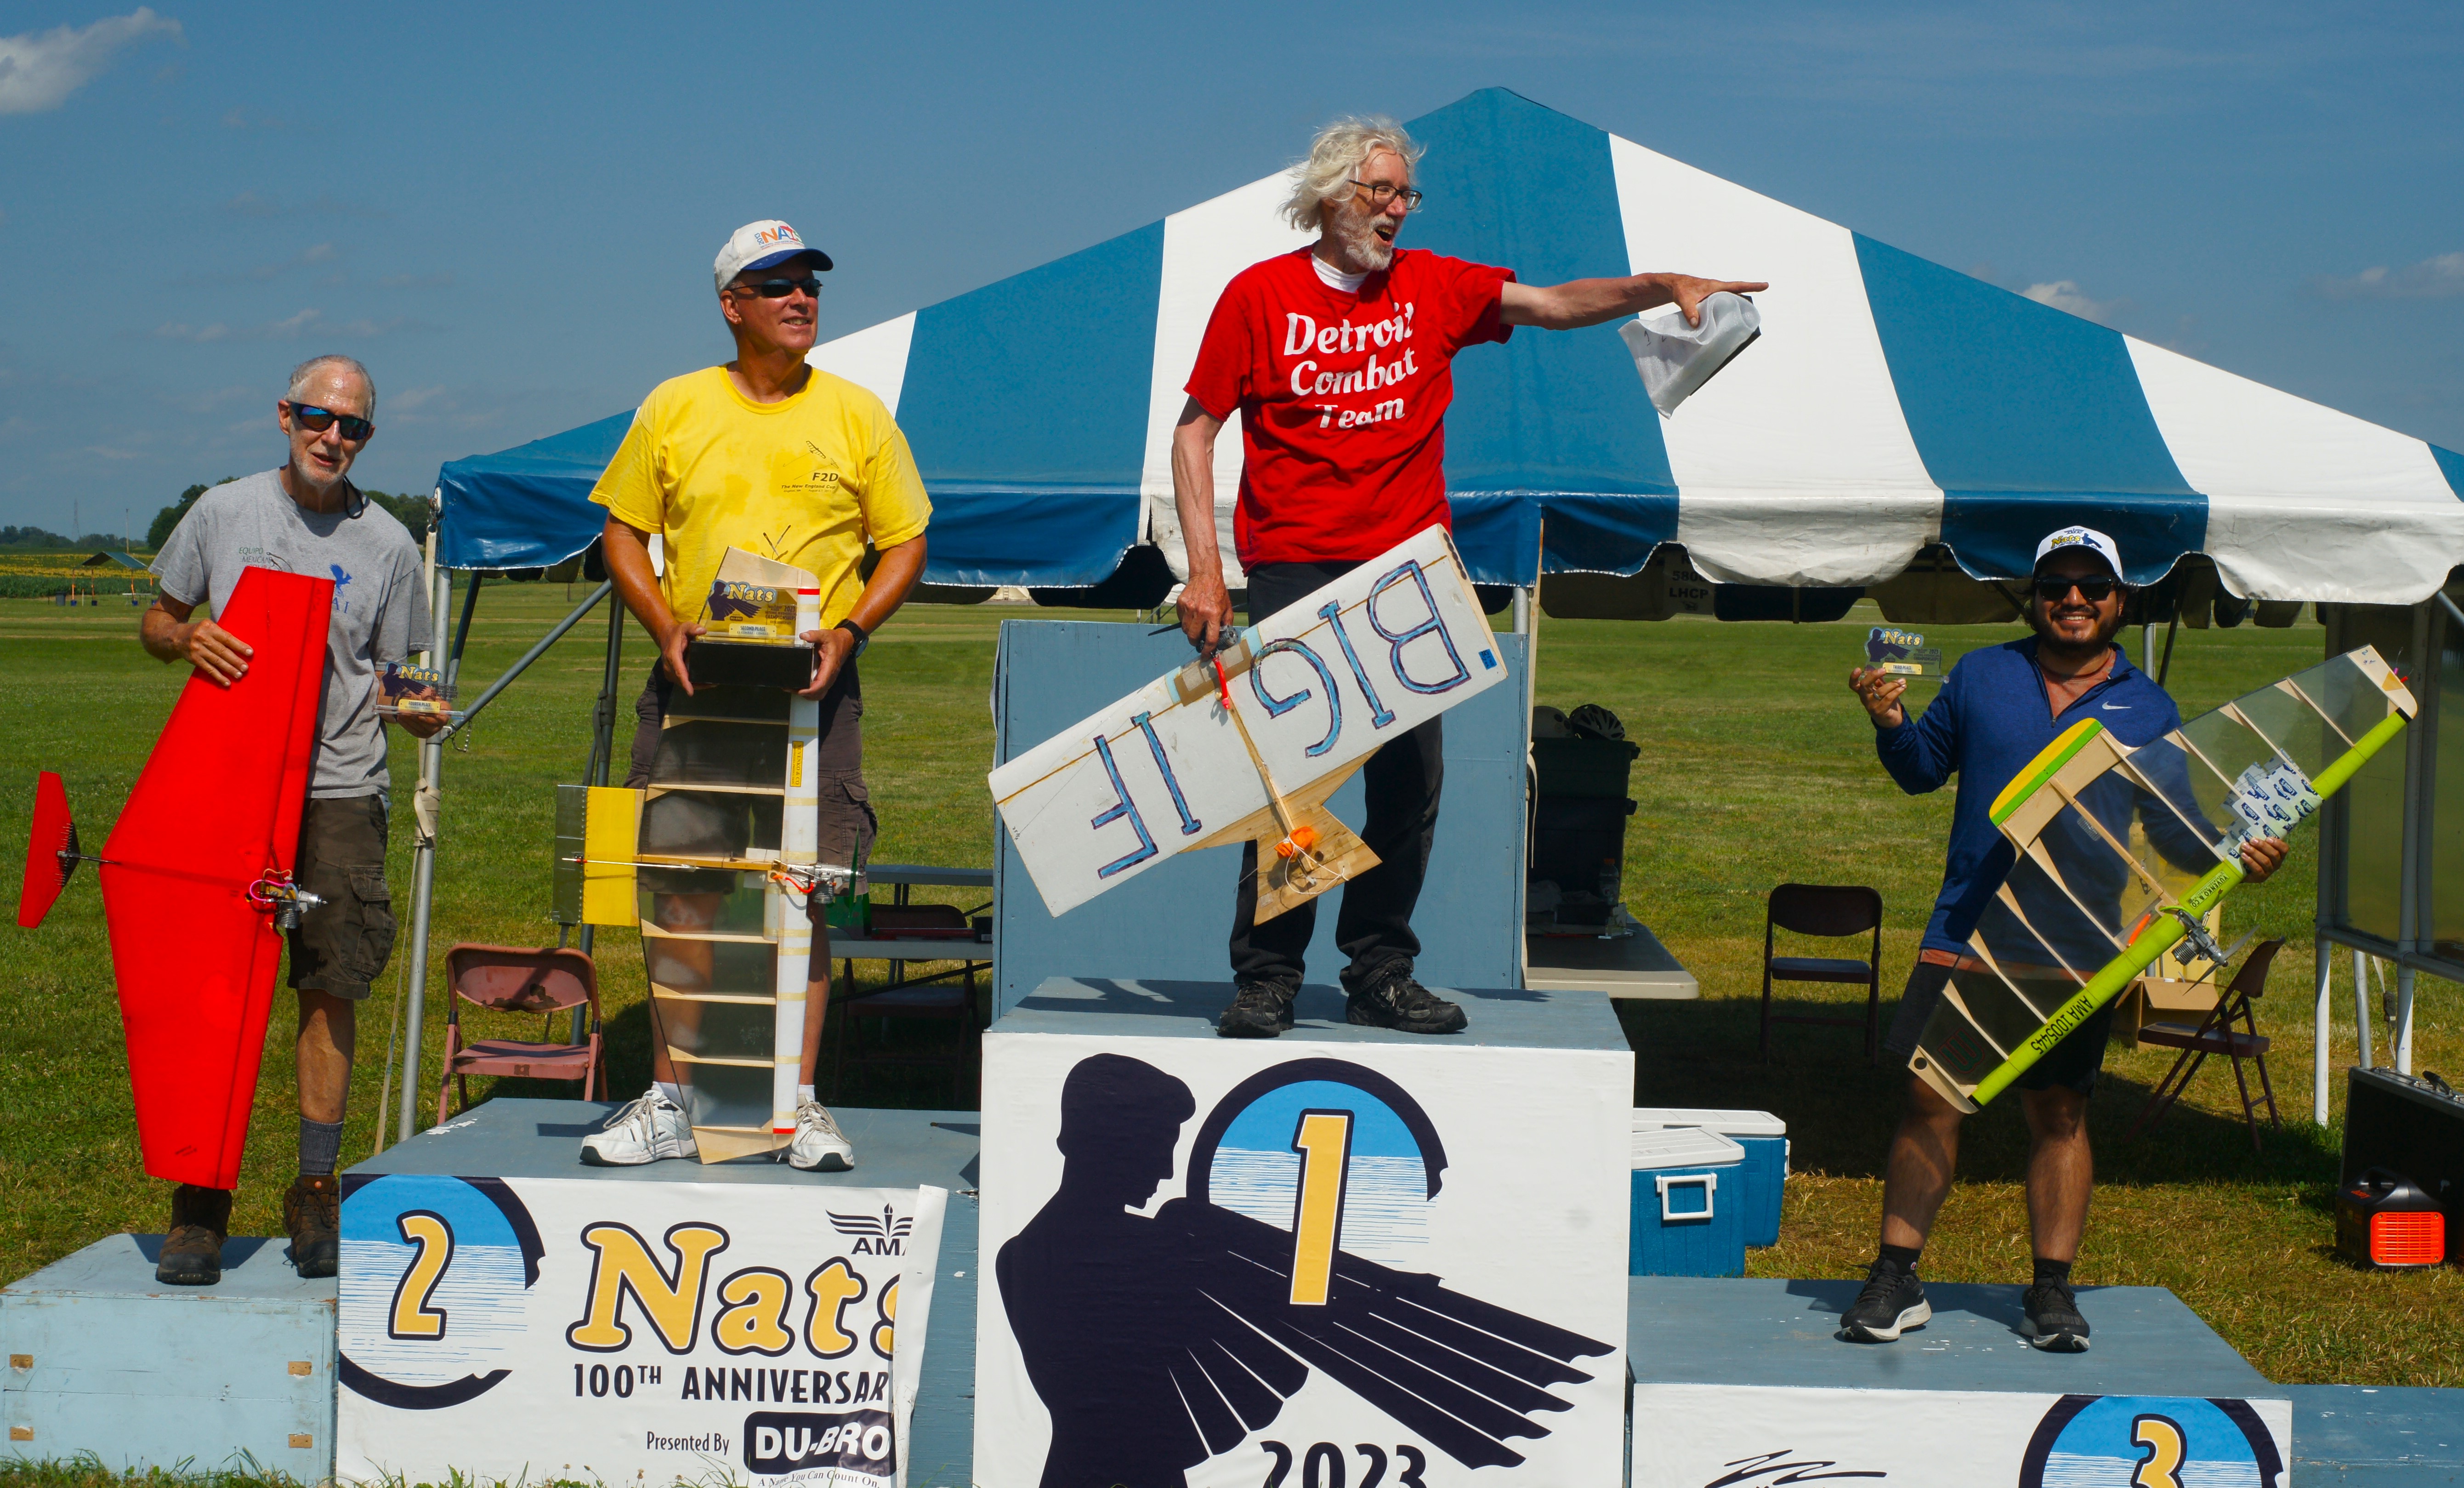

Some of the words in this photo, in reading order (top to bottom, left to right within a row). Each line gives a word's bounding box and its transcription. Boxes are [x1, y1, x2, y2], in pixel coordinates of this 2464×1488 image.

[1283, 302, 1414, 356] Detroit
[1290, 347, 1419, 396] Combat
[1315, 398, 1405, 429] Team
[812, 472, 839, 482] F2D
[2050, 534, 2081, 549] Nats
[727, 583, 774, 602] Nats
[1669, 587, 1709, 598] LHCP
[1883, 630, 1920, 646] Nats
[1249, 559, 1471, 759] BIG
[398, 665, 439, 682] Nats
[1090, 710, 1203, 880] IF
[2254, 784, 2267, 799] LOWE'S
[2282, 780, 2296, 795] LOWE'S
[2243, 803, 2258, 819] LOWE'S
[2275, 805, 2289, 821] LOWE'S
[2204, 875, 2228, 897] YUVENKO
[2191, 899, 2200, 908] CO
[2067, 995, 2093, 1020] AMA
[2031, 1015, 2073, 1054] 1005445
[1290, 1108, 1355, 1306] 1
[851, 1237, 908, 1256] AM
[388, 1210, 454, 1341] 2
[573, 1363, 662, 1399] 100TH
[681, 1367, 892, 1404] ANNIVERSAR
[647, 1431, 710, 1452] Presented
[714, 1433, 730, 1456] By
[756, 1422, 891, 1461] DU-BRO
[2130, 1413, 2187, 1488] 3
[758, 1478, 765, 1487] A
[791, 1473, 806, 1482] You
[807, 1471, 824, 1479] Can
[827, 1470, 858, 1483] Count
